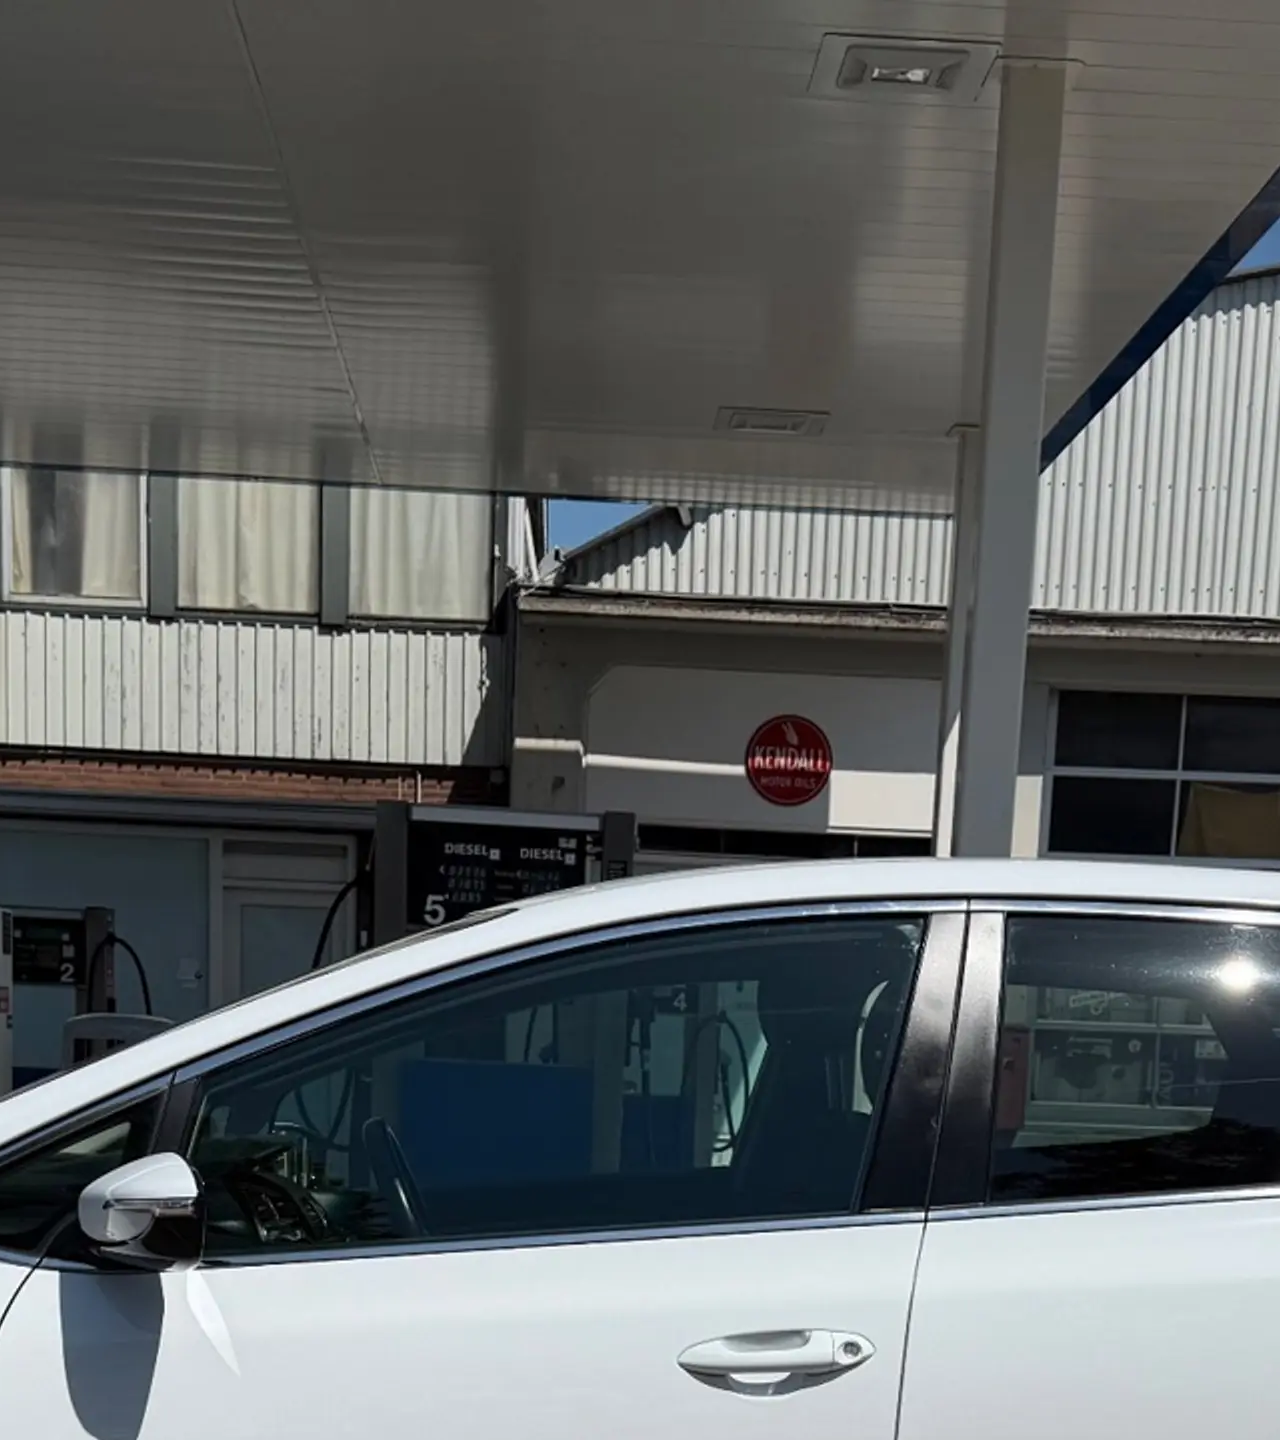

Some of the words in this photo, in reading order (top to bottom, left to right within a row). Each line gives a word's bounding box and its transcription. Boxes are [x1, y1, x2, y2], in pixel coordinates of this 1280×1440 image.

[753, 744, 825, 773] KENDALL
[444, 842, 488, 857] DIESEL
[520, 847, 563, 862] DIESEL
[423, 894, 447, 925] 5
[59, 962, 77, 983] 2
[672, 991, 688, 1013] 4
